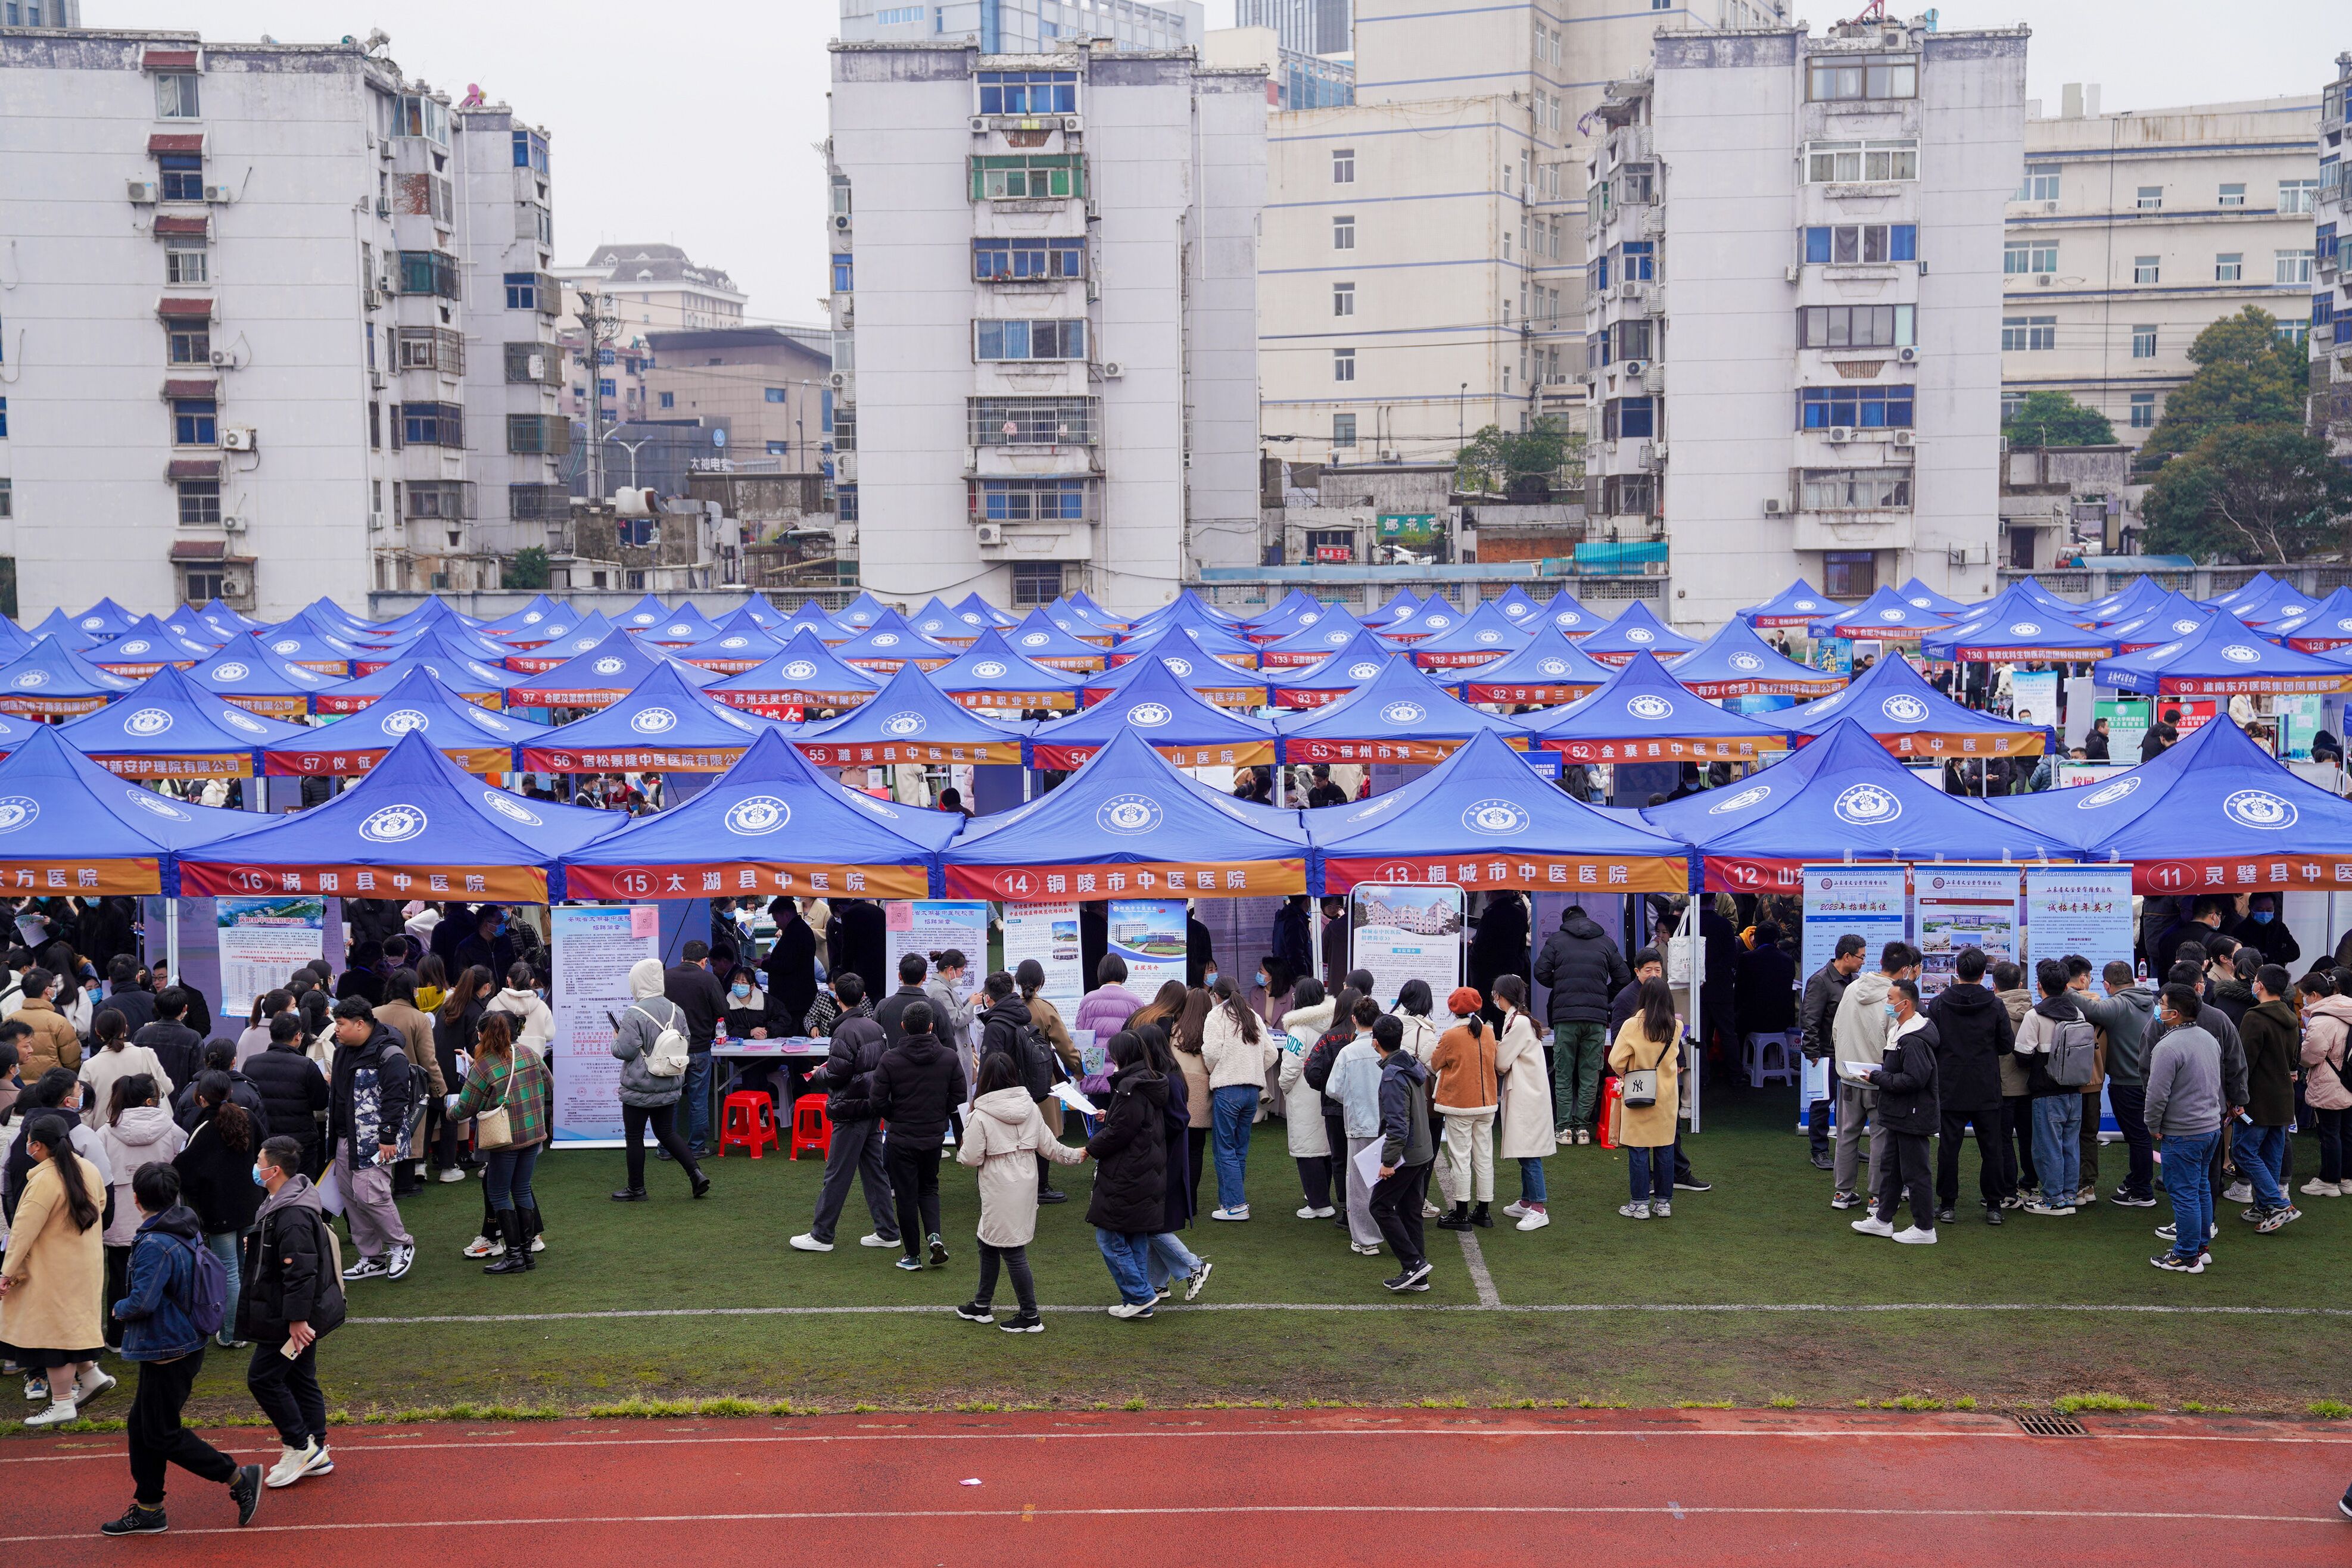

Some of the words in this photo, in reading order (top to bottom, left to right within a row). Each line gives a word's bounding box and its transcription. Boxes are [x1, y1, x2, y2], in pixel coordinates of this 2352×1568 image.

[1967, 651, 1982, 659] 130
[519, 661, 534, 669] 138
[2180, 682, 2193, 692] 90
[523, 693, 535, 703] 97
[714, 694, 725, 704] 96
[1298, 694, 1311, 703] 93
[1494, 690, 1506, 699] 92
[335, 700, 348, 710] 98
[1572, 746, 1588, 757] 52
[1601, 742, 1753, 759] 金寨县中医医院
[1877, 737, 2008, 752] 县中医院
[809, 749, 825, 760] 55
[837, 747, 988, 762] 濉溪县中医医院
[1312, 745, 1328, 757] 53
[304, 758, 320, 770] 57
[553, 755, 569, 767] 56
[1071, 752, 1088, 764] 54
[0, 868, 98, 889] 方医院
[1385, 867, 1409, 883] 13
[1428, 862, 1628, 884] 桐城市中医医院
[1734, 866, 1758, 884] 12
[2159, 868, 2181, 886] 11
[2205, 862, 2352, 886] 灵璧县中医
[239, 873, 263, 889] 16
[282, 872, 486, 893] 涡阳县中医院
[624, 875, 647, 893] 15
[666, 869, 865, 892] 太湖县中医院
[1004, 874, 1028, 893] 14
[1046, 870, 1247, 893] 铜陵市中医医院
[1014, 901, 1068, 909] 欢迎报考铜陵市中医医院
[1820, 902, 1887, 912] 2023年招聘岗位
[2047, 902, 2113, 913] 诚招青年英才
[1009, 908, 1073, 917] 中医住院医师规范化培训基地
[1633, 1079, 1643, 1092] NY
[410, 1108, 419, 1123] LEGION
